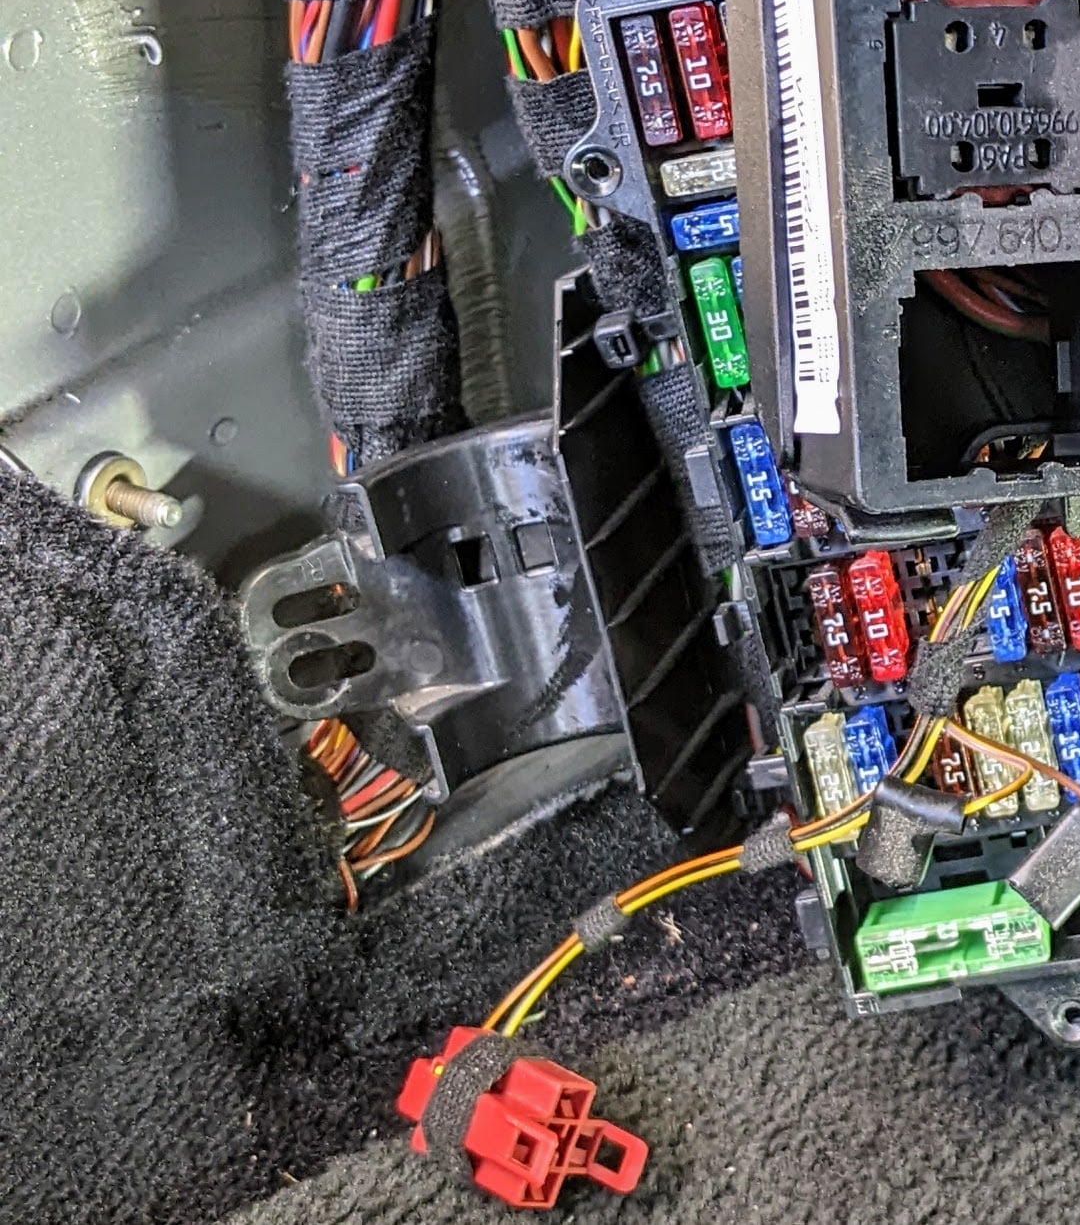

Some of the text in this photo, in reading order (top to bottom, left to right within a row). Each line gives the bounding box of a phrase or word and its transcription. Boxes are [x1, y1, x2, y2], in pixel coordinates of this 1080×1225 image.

[637, 60, 663, 97] 7.5
[686, 55, 712, 90] 10
[707, 310, 732, 341] 30
[747, 471, 772, 502] 15
[1027, 581, 1052, 615] 7.5
[823, 612, 849, 647] 7.5
[864, 608, 889, 640] 10
[1058, 731, 1080, 761] 15
[940, 752, 965, 784] 7.5
[820, 773, 843, 802] 25
